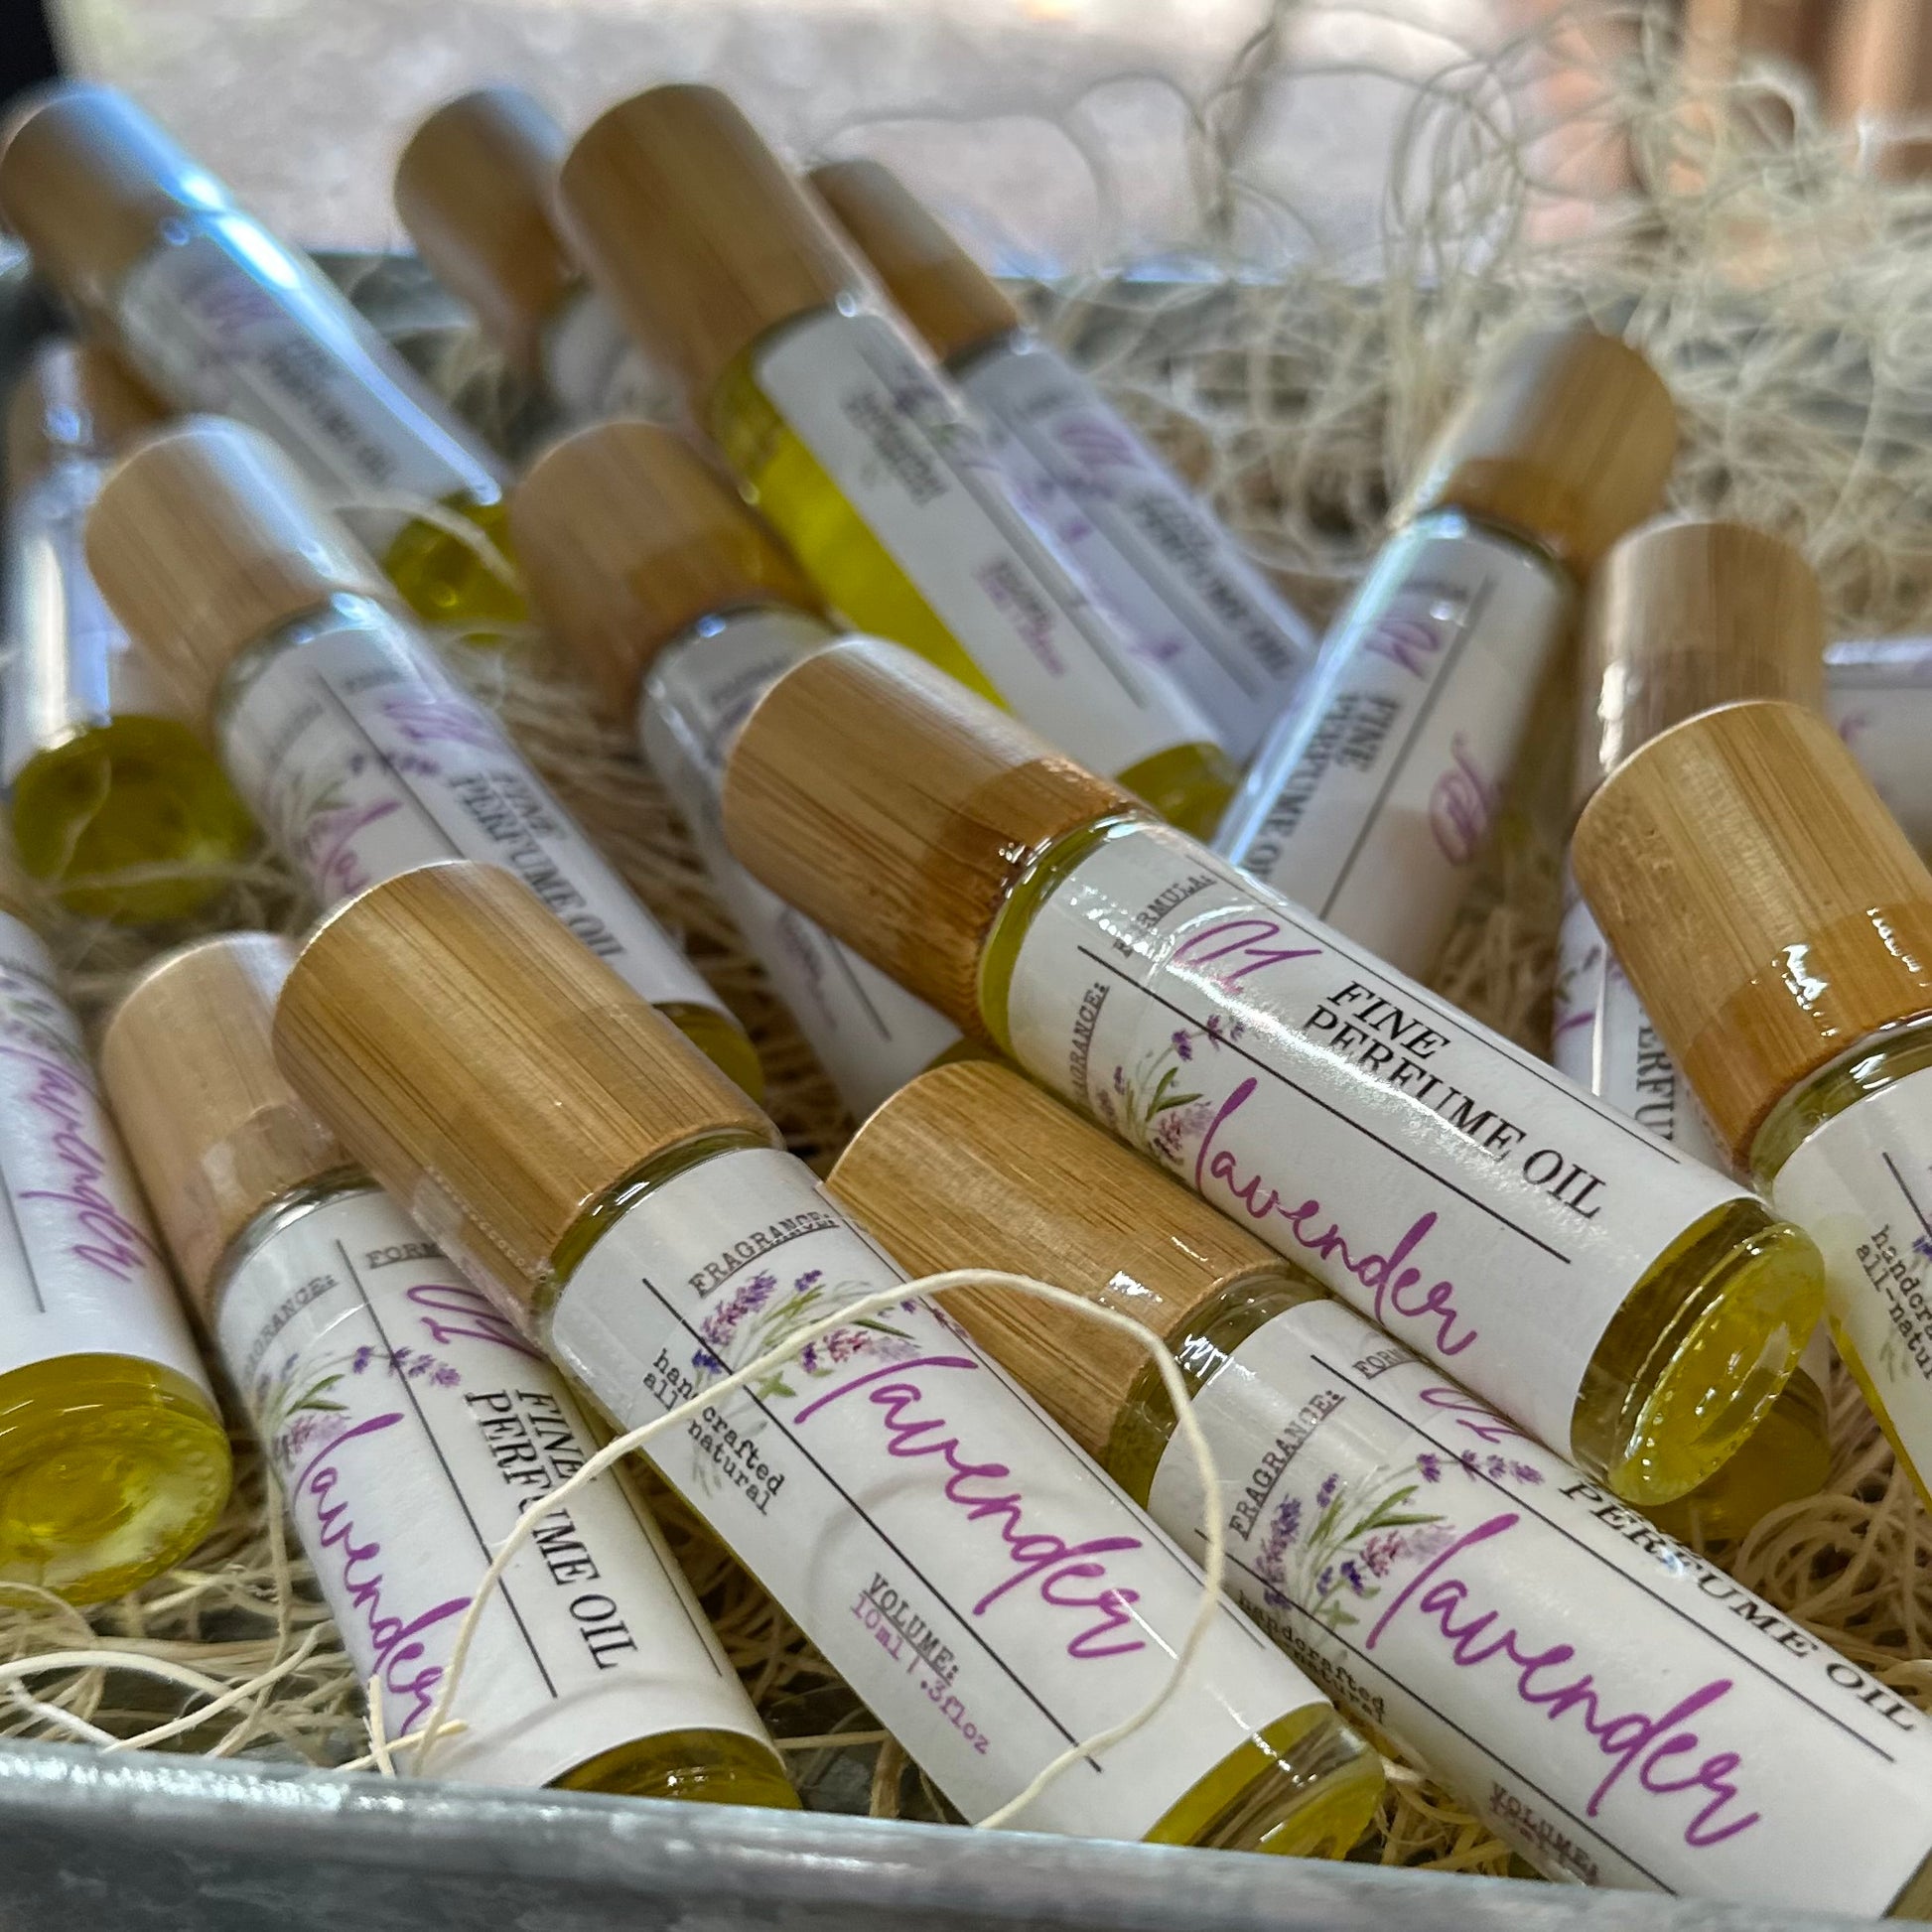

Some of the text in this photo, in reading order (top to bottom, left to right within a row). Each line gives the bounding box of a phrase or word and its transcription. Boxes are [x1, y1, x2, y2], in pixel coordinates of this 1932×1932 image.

[447, 771, 588, 918] PERFUME
[1113, 873, 1217, 959] FRMULA:
[1323, 980, 1452, 1064] FINE
[1303, 1003, 1608, 1220] PERFUME OIL
[688, 1210, 841, 1300] FRAGRANCE:
[1193, 1075, 1478, 1357] lavender
[652, 1347, 786, 1496] hancrafted
[1228, 1389, 1346, 1542] FRAGRANCE:
[793, 1354, 1147, 1661] lavender
[568, 1591, 638, 1671] OIL
[863, 1572, 960, 1687] VOLUME:
[1365, 1512, 1762, 1849] lavender
[1825, 1661, 1917, 1732] OIL
